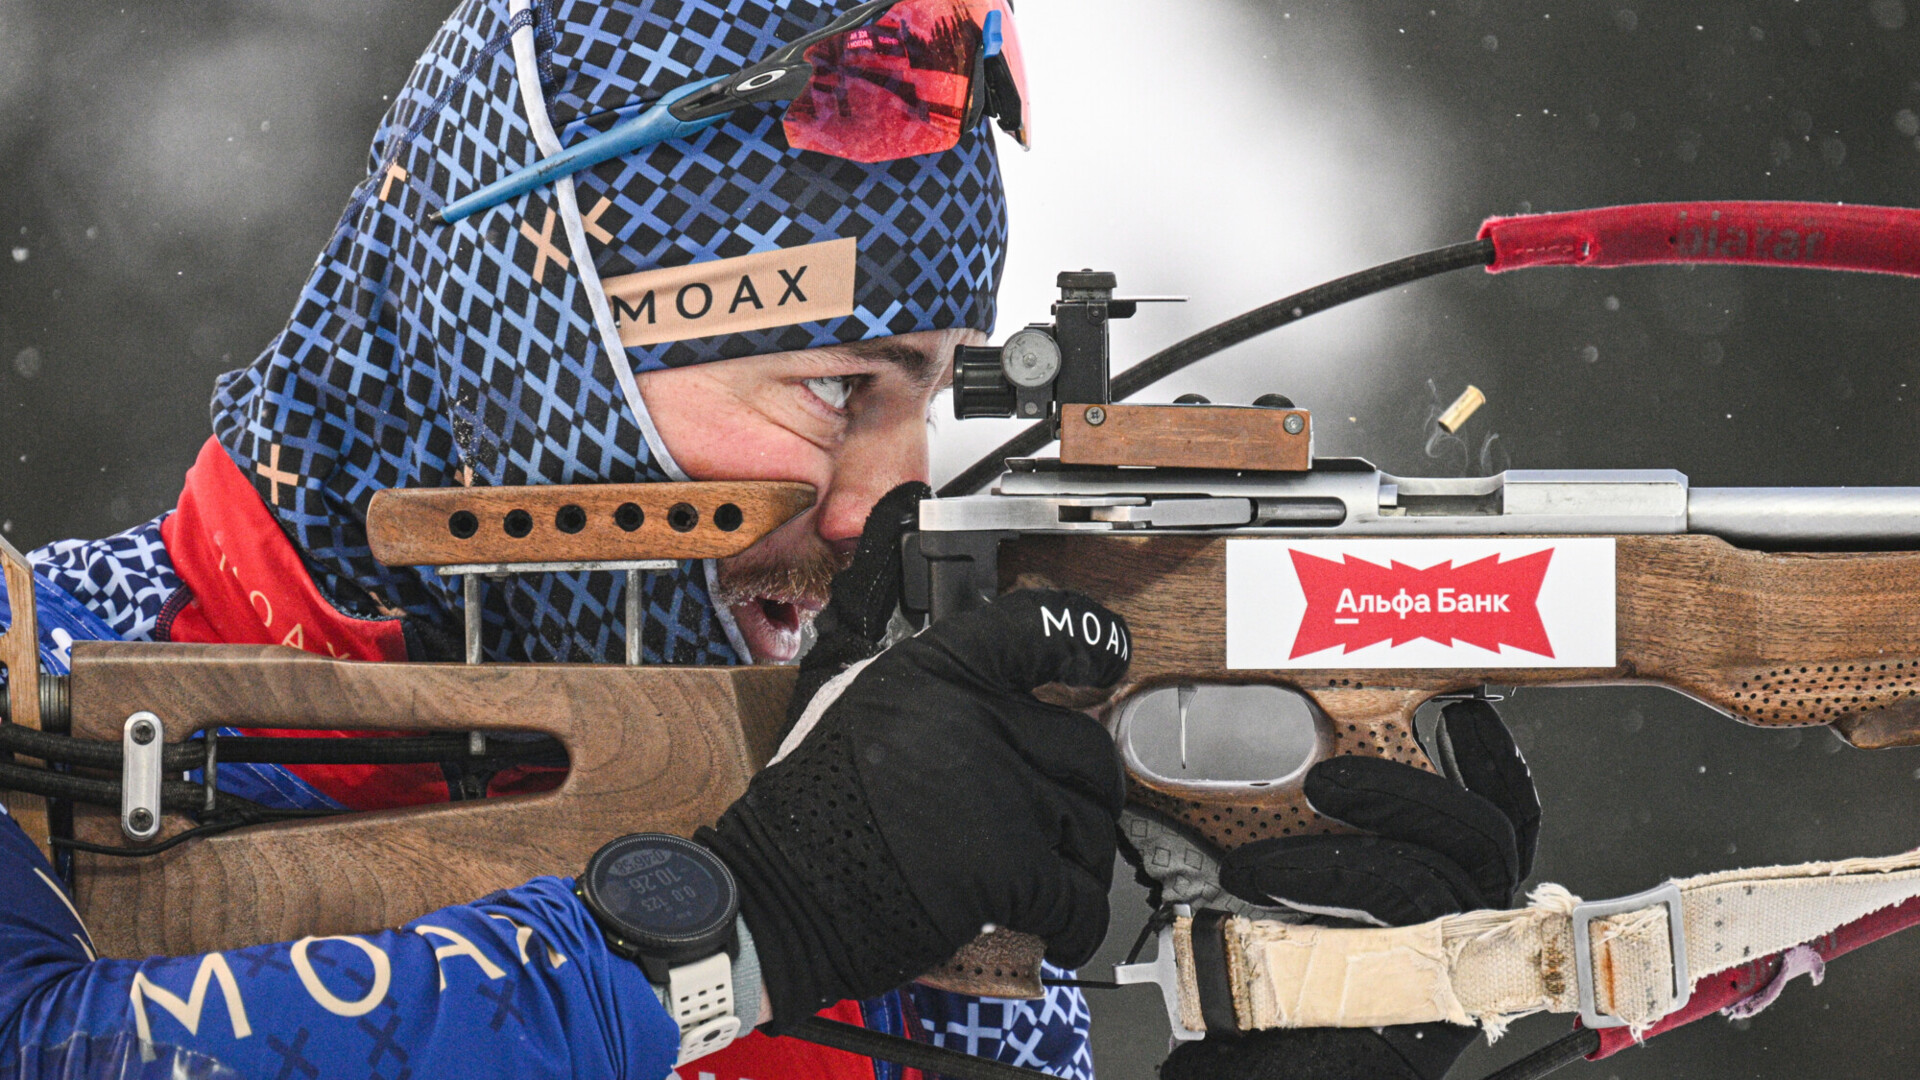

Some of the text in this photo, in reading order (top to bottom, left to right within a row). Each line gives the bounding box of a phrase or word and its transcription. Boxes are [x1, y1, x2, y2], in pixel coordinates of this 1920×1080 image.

[611, 265, 808, 329] MOAX
[1334, 588, 1511, 624] Альфа Банк
[629, 866, 682, 894] 10.26
